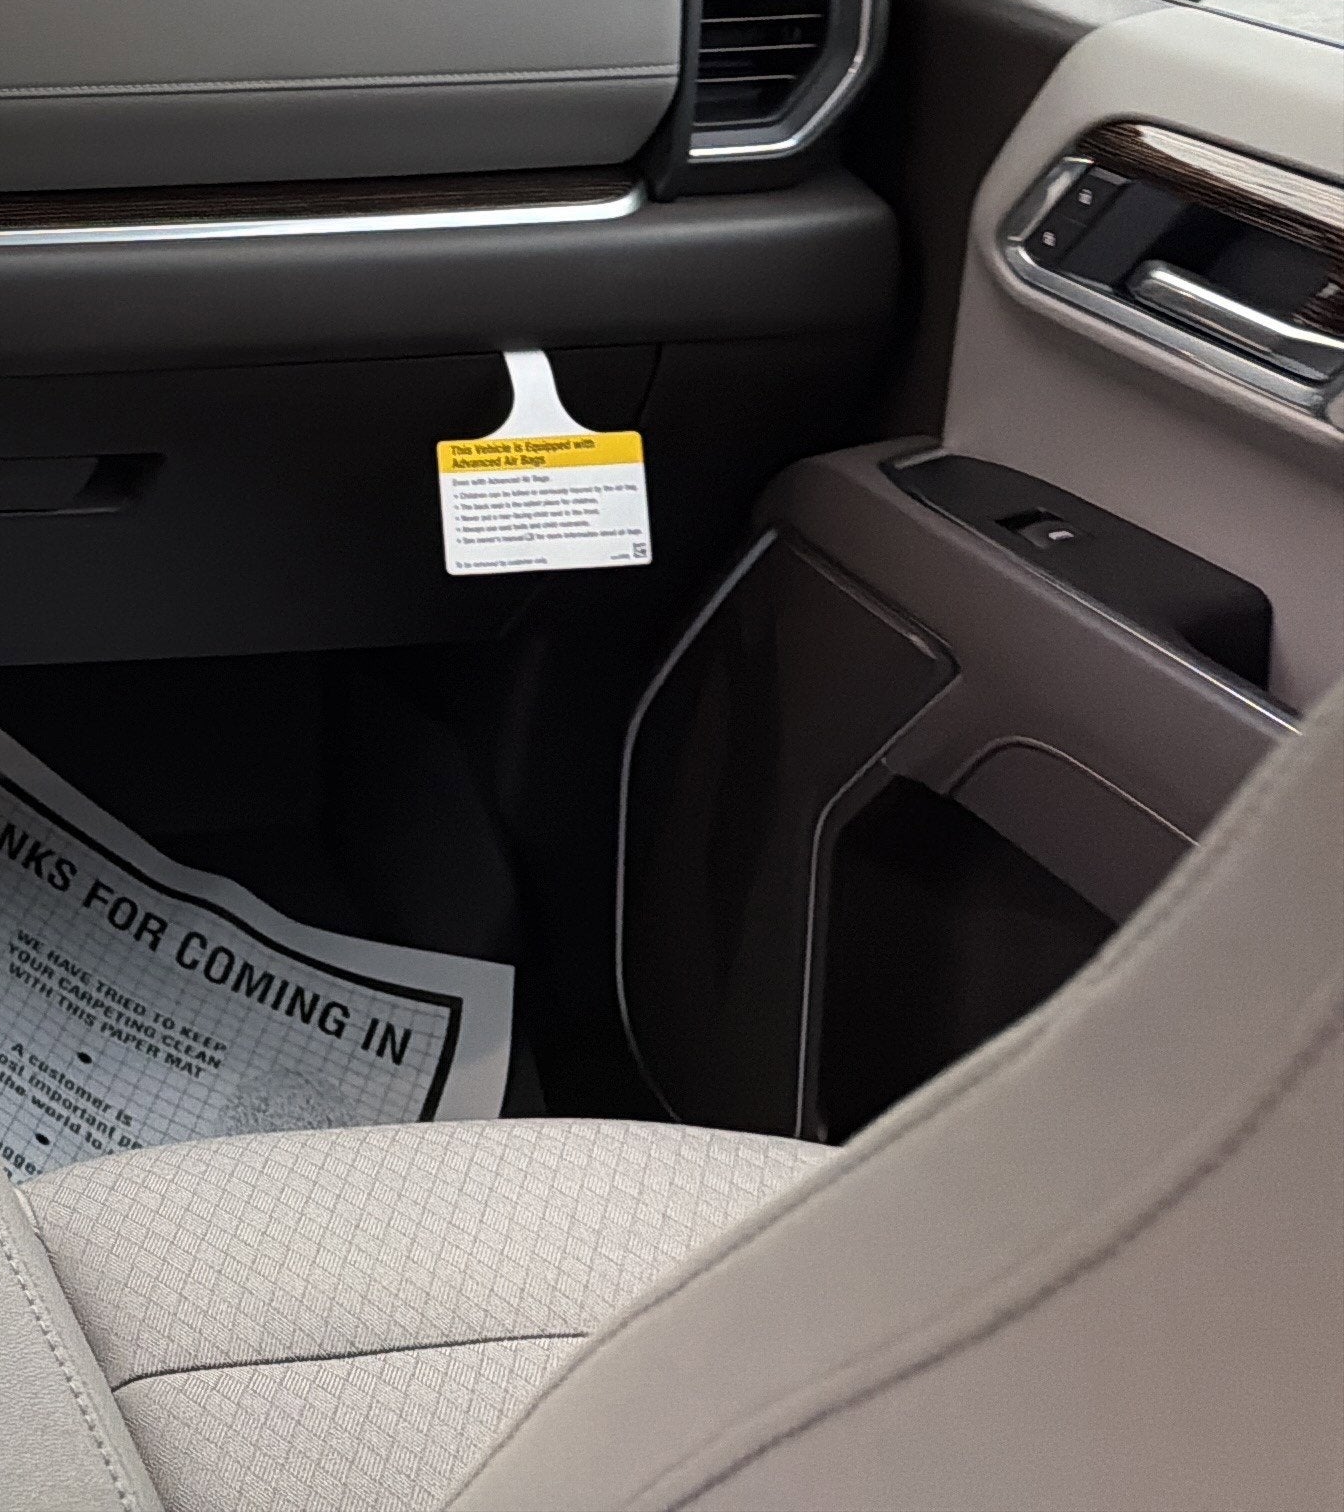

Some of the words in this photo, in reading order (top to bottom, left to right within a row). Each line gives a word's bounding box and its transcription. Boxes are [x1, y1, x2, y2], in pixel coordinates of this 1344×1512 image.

[450, 444, 472, 456] This
[474, 442, 511, 455] Vehicle
[513, 442, 524, 453] is
[525, 439, 571, 453] Equipped
[573, 438, 596, 449] with
[452, 457, 502, 469] Advanced
[504, 456, 518, 466] Air
[520, 454, 546, 467] Bags
[8, 940, 56, 981] YOUR
[58, 976, 157, 1039] CARPETING
[161, 1033, 223, 1071] CLEAN
[17, 929, 44, 953] WE
[47, 949, 93, 985] HAVE
[95, 979, 148, 1018] TRIED
[153, 1008, 176, 1031] TO
[179, 1025, 228, 1054] KEEP
[83, 878, 169, 952] FOR
[175, 931, 351, 1038] COMING
[360, 1017, 413, 1066] IN
[9, 962, 54, 999] WITH
[58, 994, 99, 1029] THIS
[100, 1021, 161, 1059] PAPER
[164, 1051, 207, 1080] MAT
[11, 1042, 24, 1058] A
[28, 1054, 113, 1113] customer
[115, 1109, 134, 1127] is
[28, 1075, 117, 1139] important
[31, 1094, 83, 1135] world
[84, 1131, 104, 1150] to
